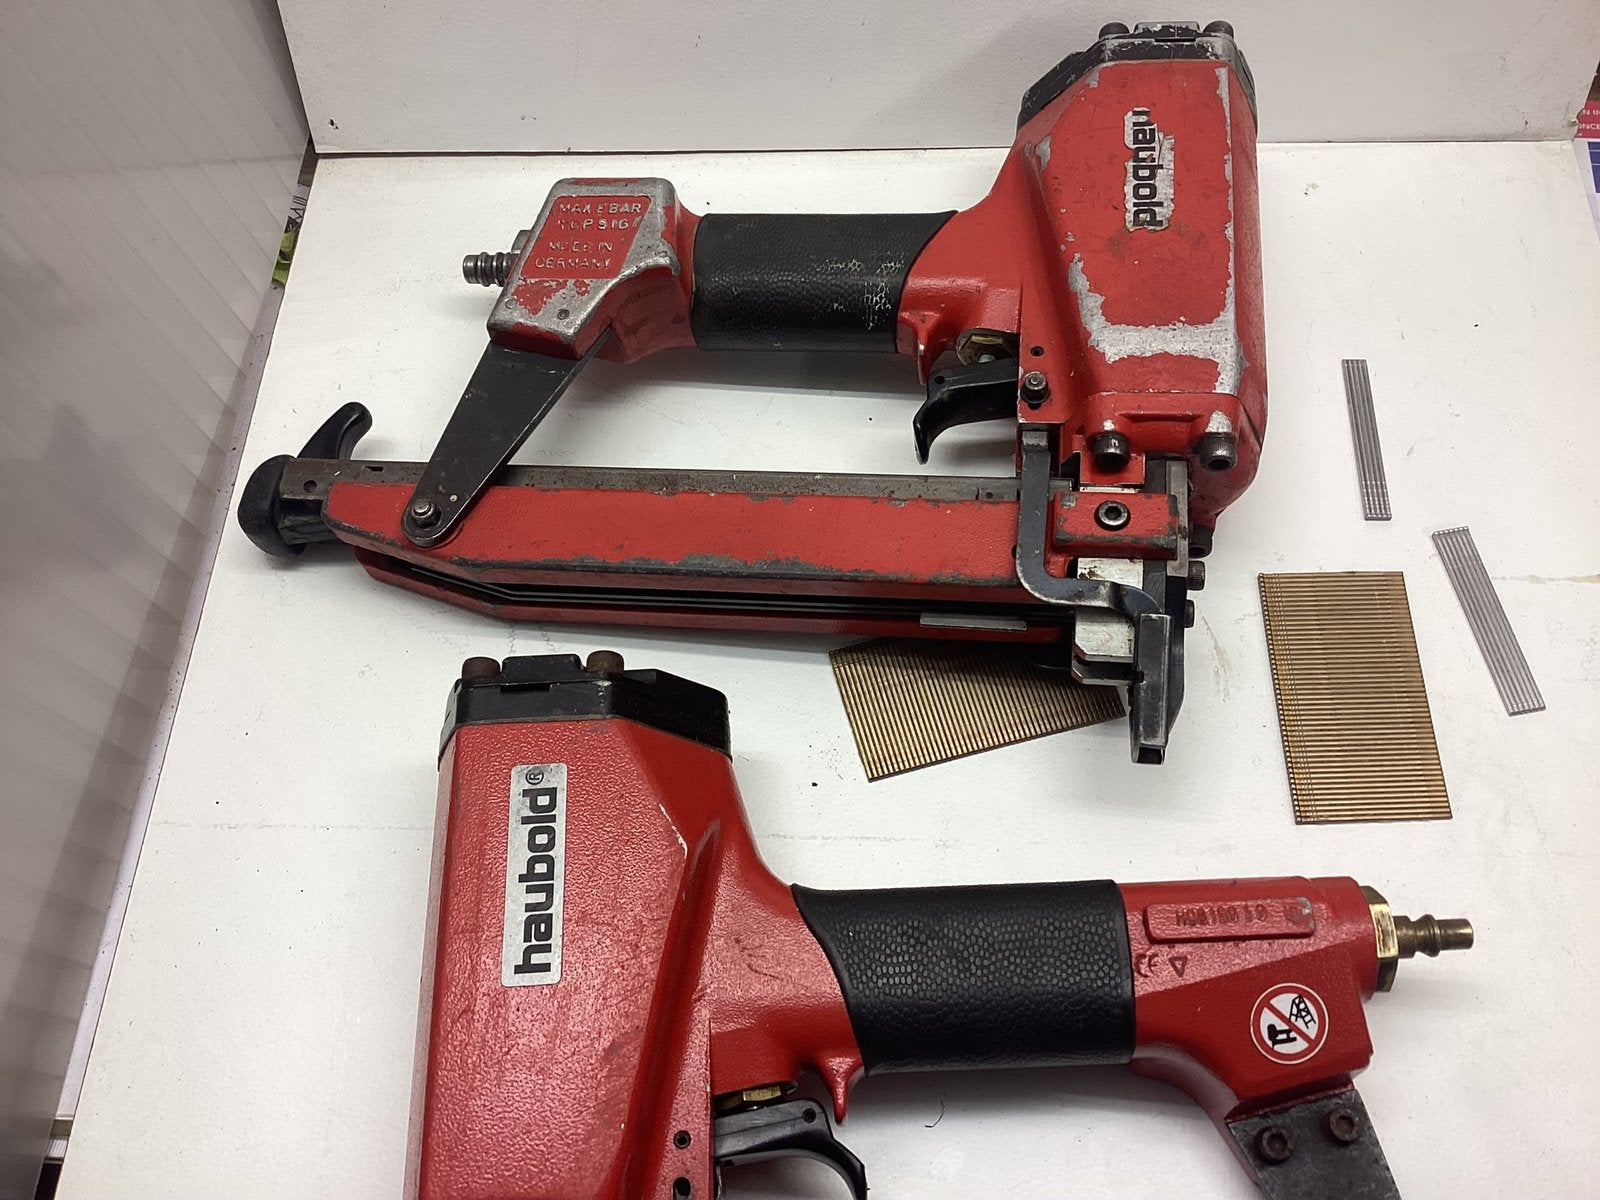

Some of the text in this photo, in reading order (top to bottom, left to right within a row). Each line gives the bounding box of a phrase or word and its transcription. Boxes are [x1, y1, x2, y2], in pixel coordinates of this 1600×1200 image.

[609, 203, 642, 214] BAR
[598, 241, 613, 252] IN
[535, 257, 611, 268] GERMANY
